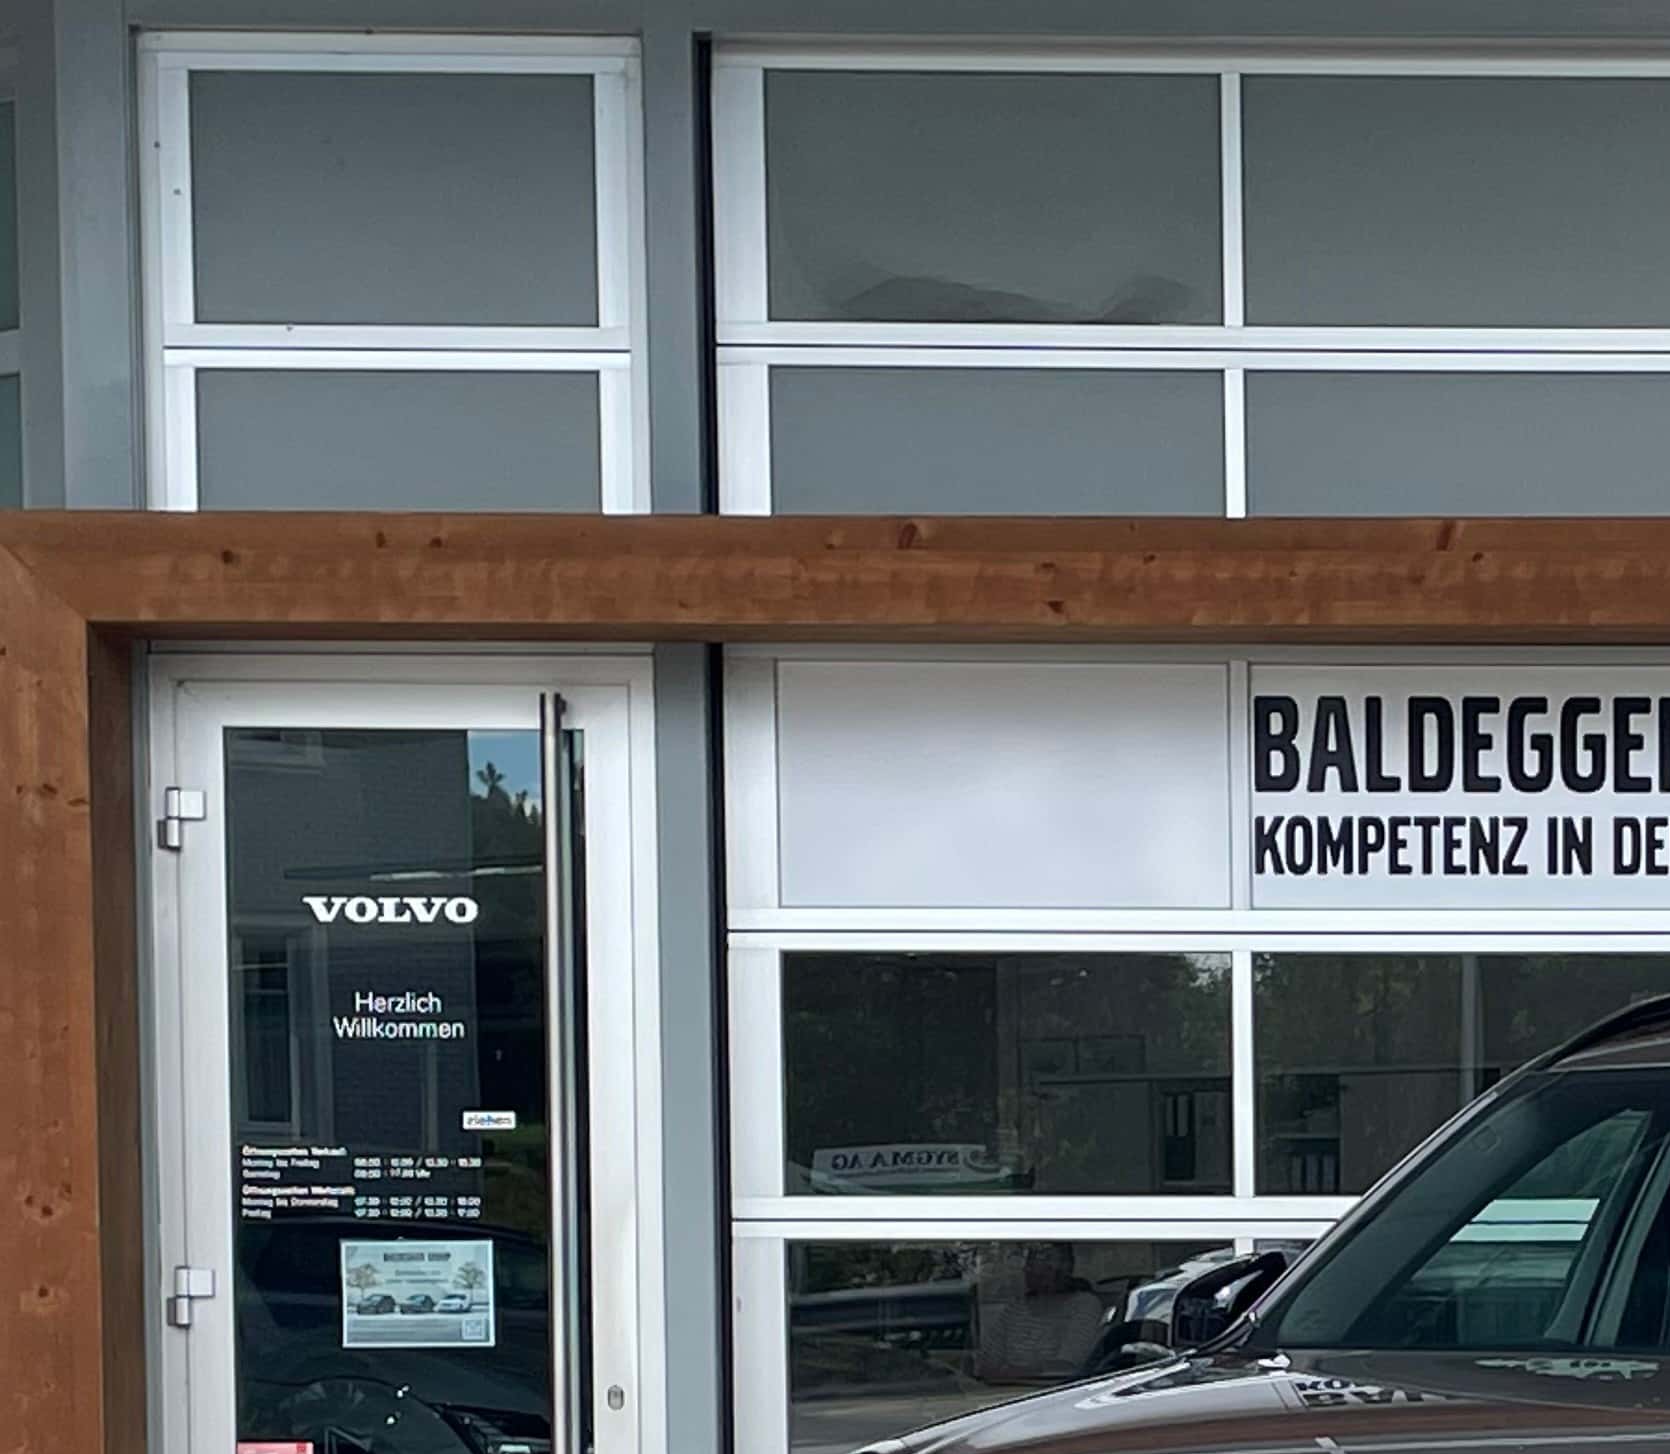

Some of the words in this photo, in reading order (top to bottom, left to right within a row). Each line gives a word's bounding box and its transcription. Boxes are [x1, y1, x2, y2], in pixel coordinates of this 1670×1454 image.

[1254, 816, 1528, 875] KOMPETENZ
[1548, 817, 1593, 875] IN
[302, 896, 479, 923] VOLVO
[355, 991, 442, 1013] Herzlich
[333, 1017, 465, 1039] Willkommen
